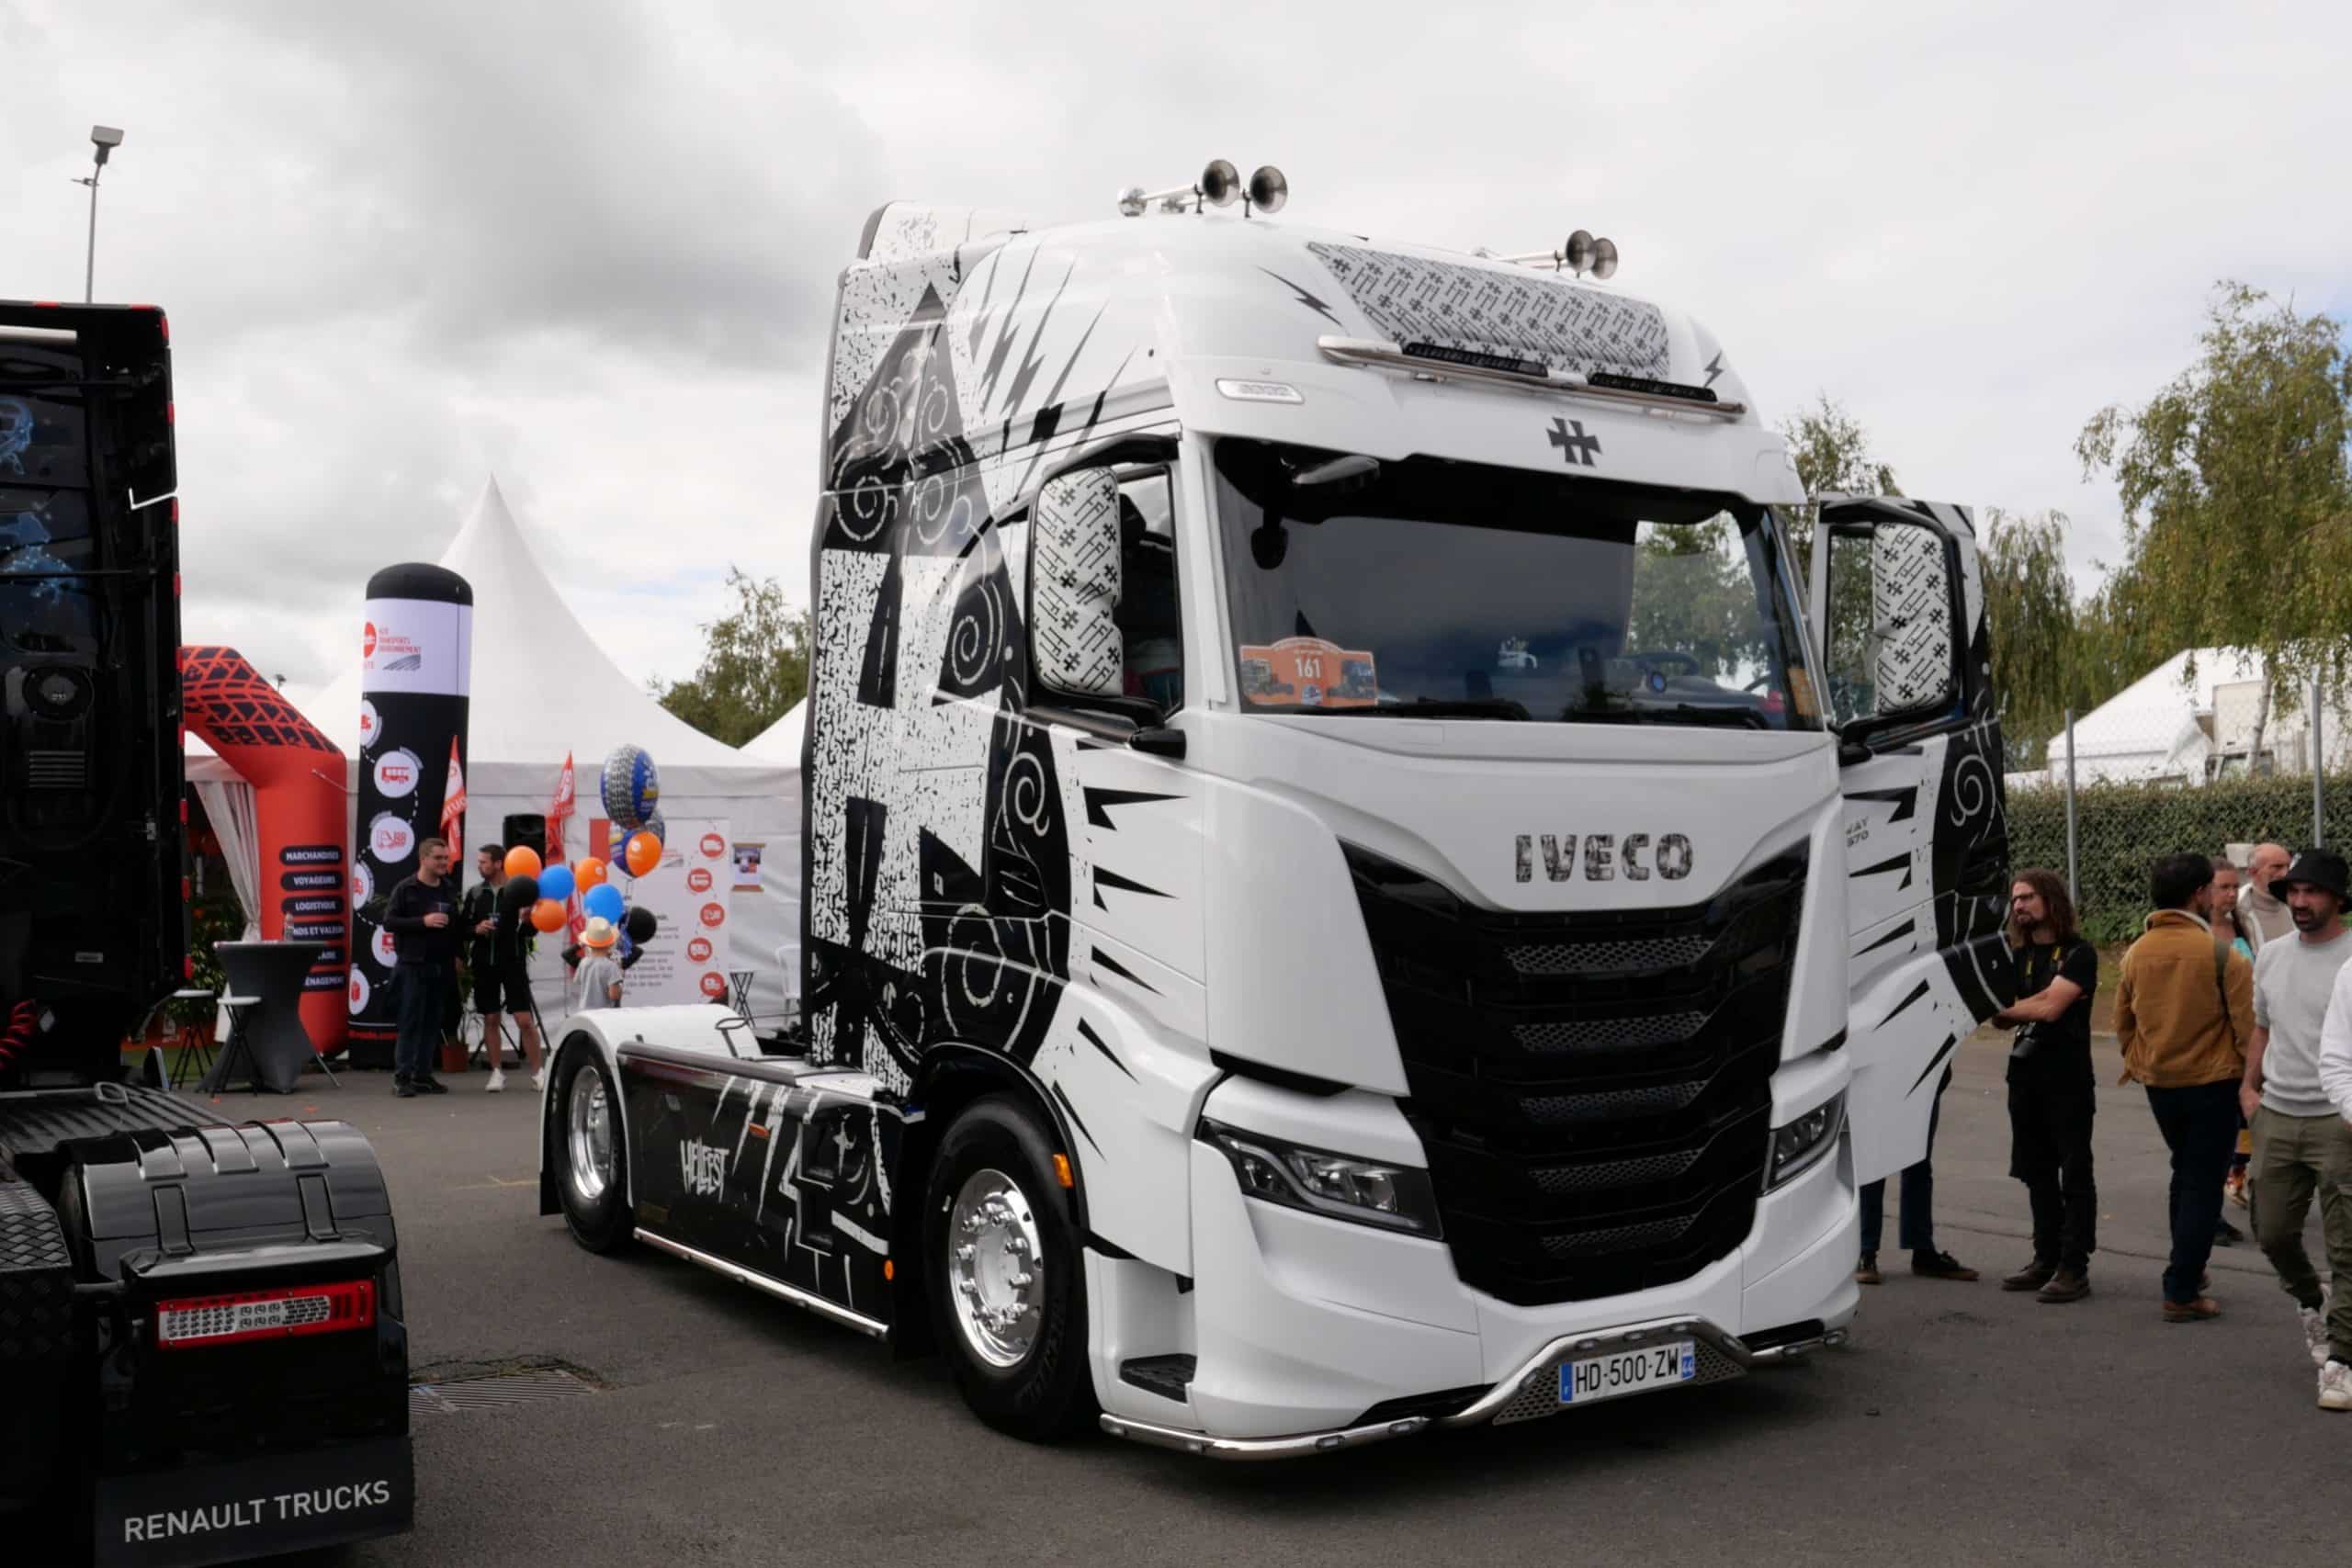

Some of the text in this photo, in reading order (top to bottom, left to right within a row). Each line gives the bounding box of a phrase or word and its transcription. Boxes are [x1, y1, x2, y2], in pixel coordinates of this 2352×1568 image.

[1295, 659, 1321, 678] 161
[1516, 833, 1693, 882] IVECO
[1576, 1348, 1679, 1393] HD-500-ZW
[125, 1480, 390, 1543] RENAULT TRUCKS
